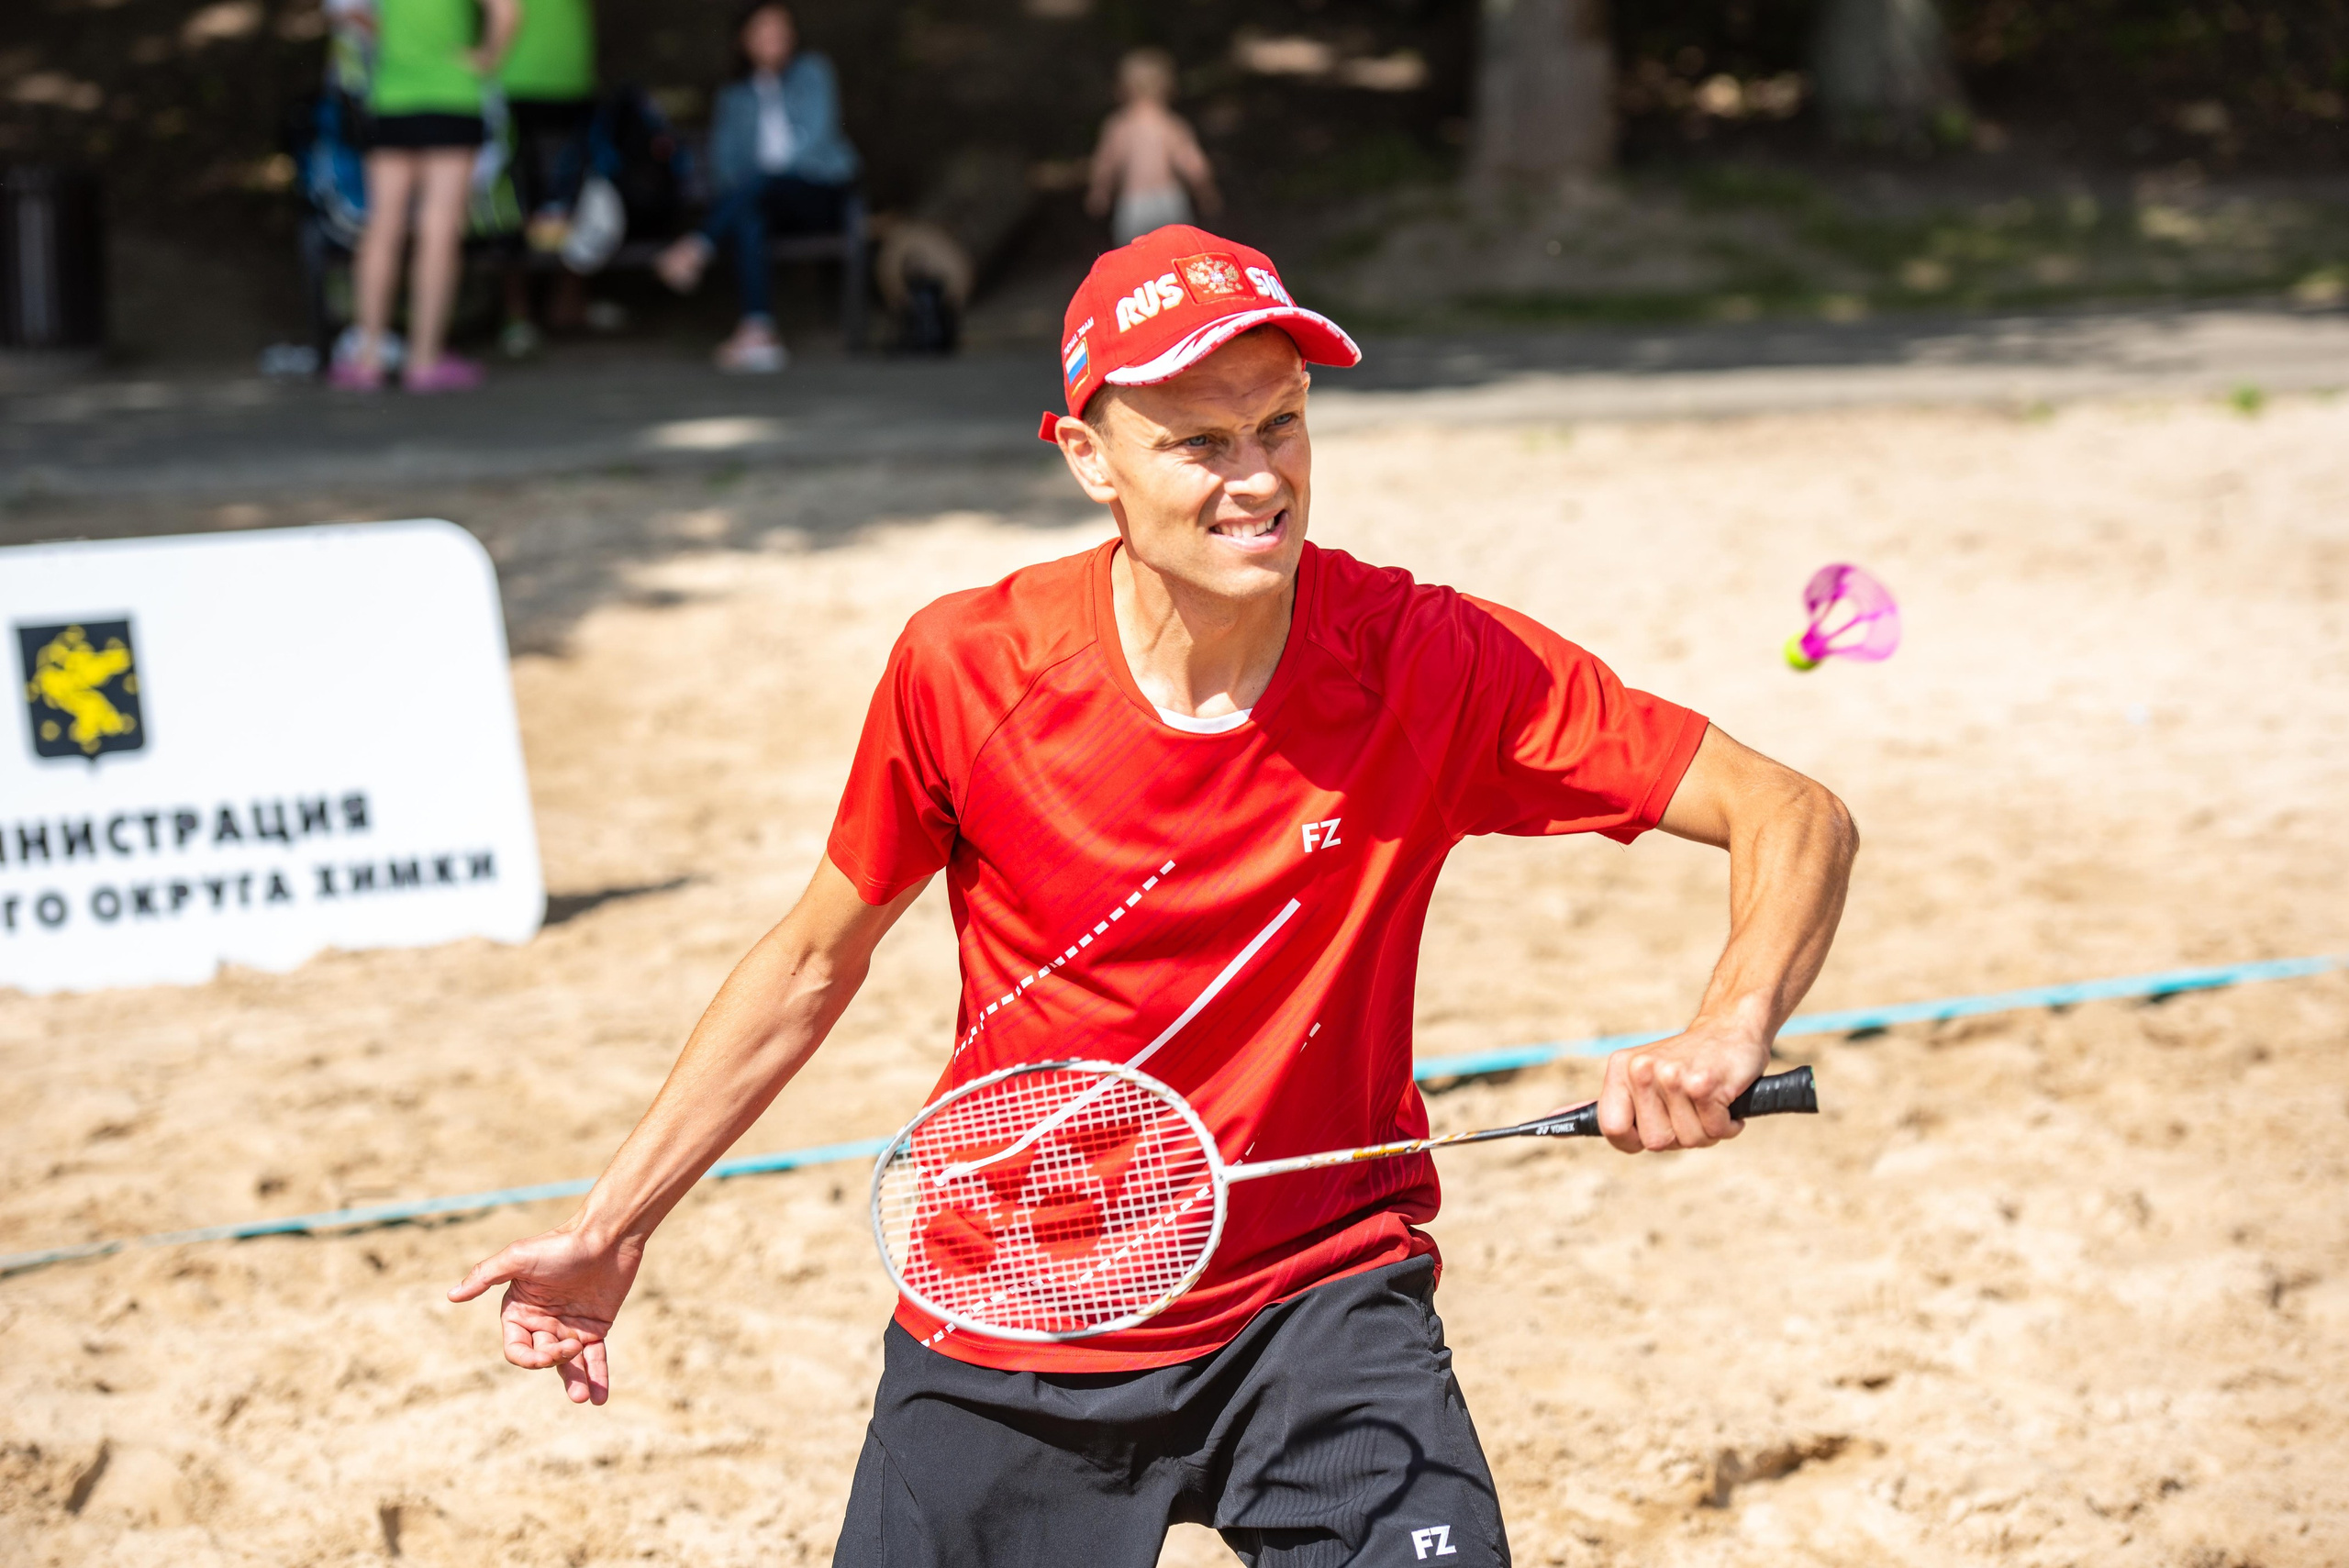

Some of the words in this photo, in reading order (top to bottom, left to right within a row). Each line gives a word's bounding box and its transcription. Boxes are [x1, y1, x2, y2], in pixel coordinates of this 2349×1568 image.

[1115, 272, 1184, 333] RUS
[0, 793, 371, 864] НИСТРАЦИЯ
[1301, 817, 1341, 853] FZ
[90, 872, 292, 921] ОКРУГА
[316, 853, 496, 896] ХИМКИ
[1550, 1122, 1575, 1134] YONEX
[1411, 1525, 1457, 1560] FZ
